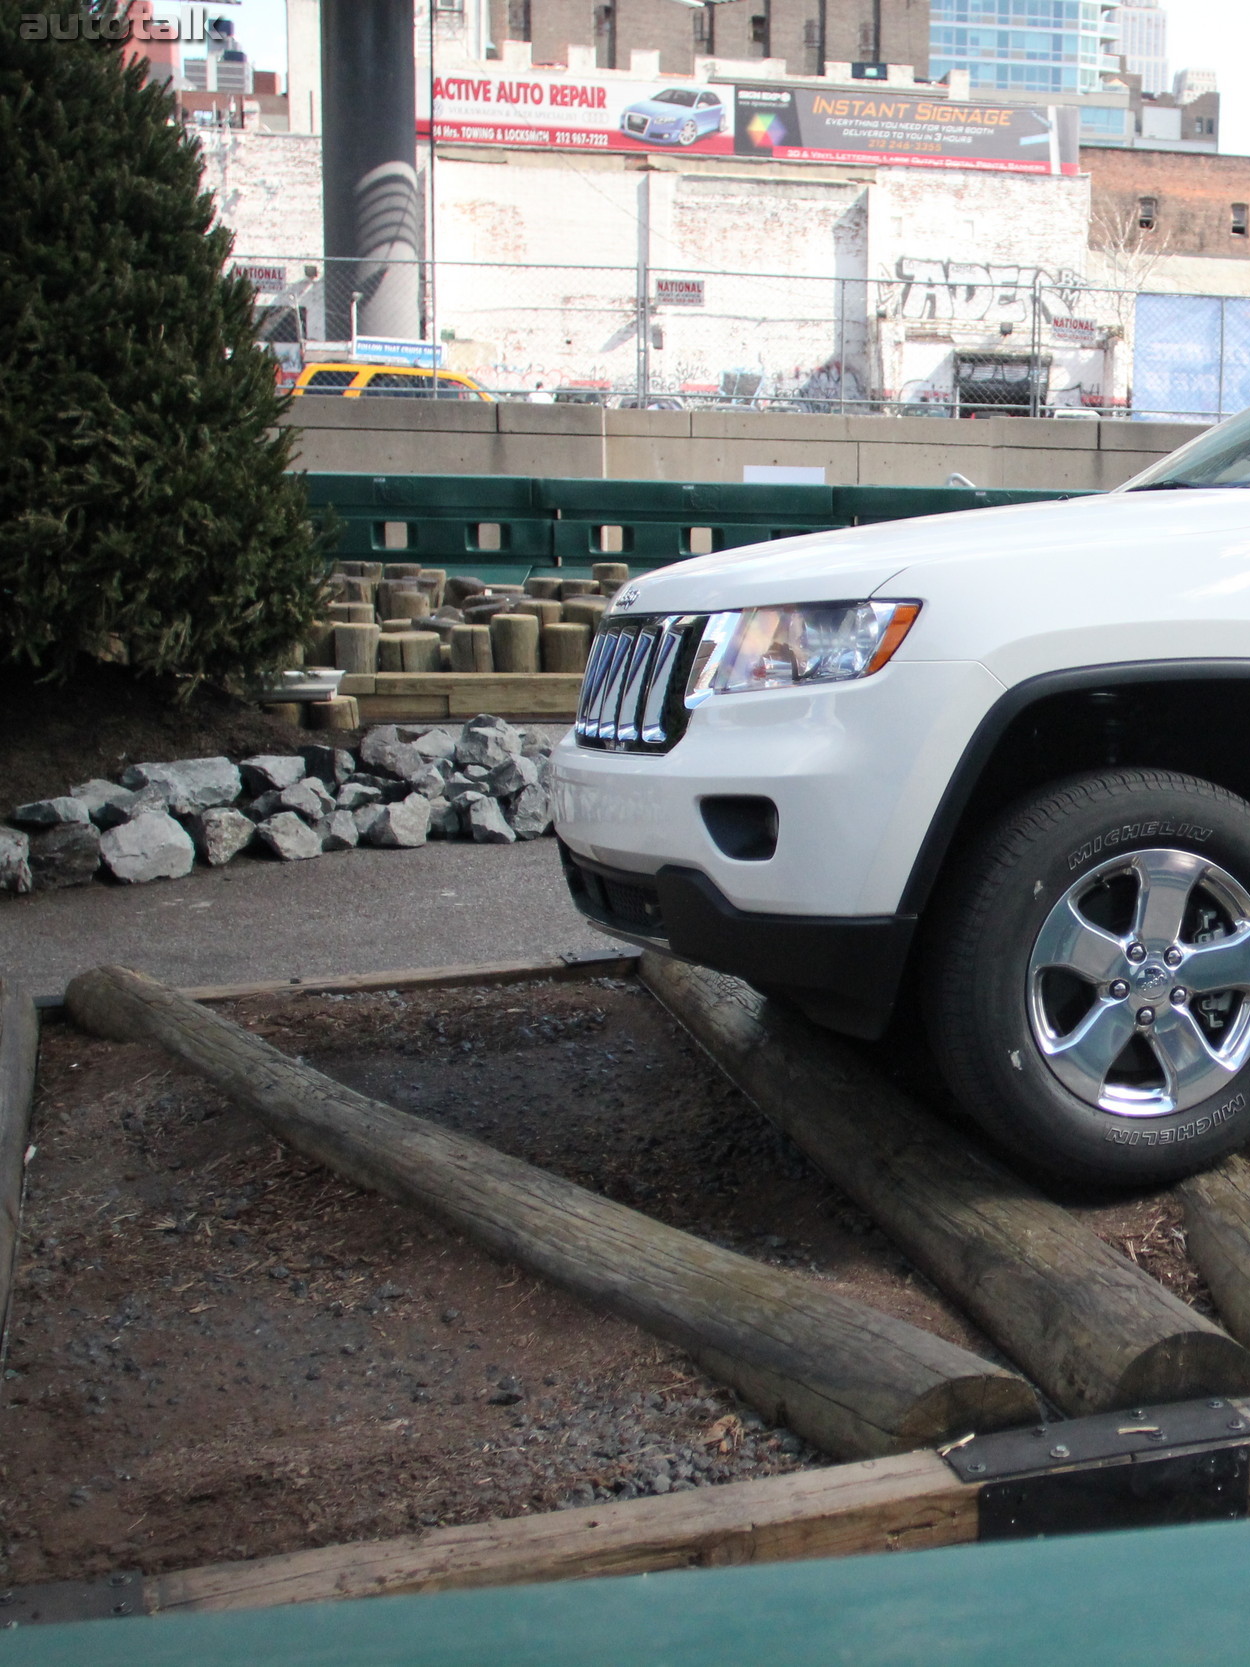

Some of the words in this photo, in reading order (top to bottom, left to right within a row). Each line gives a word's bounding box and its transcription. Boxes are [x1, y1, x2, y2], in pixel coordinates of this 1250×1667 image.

[433, 77, 491, 102] ACTIVE
[496, 81, 543, 105] AUTO
[549, 84, 606, 109] REPAIR
[812, 95, 911, 118] INSTANT
[915, 102, 1015, 126] SIGNAGE
[461, 126, 495, 139] TOWING
[505, 128, 549, 142] LOCKSMITH
[556, 132, 570, 143] 212
[825, 117, 879, 128] EVERYTHING
[880, 121, 897, 129] YOU
[899, 122, 921, 131] NEED
[922, 123, 939, 132] FOR
[941, 125, 963, 133] YOUR
[964, 126, 994, 135] BOOTH
[842, 129, 890, 138] DELIVERED
[892, 131, 904, 139] TO
[905, 132, 922, 140] YOU
[934, 133, 941, 141] 3
[943, 135, 973, 144] HOURS
[657, 280, 702, 293] NATIONAL
[1053, 316, 1095, 332] NATIONAL
[1067, 821, 1214, 871] MICHELIN
[1105, 1093, 1246, 1146] MICHELIN
